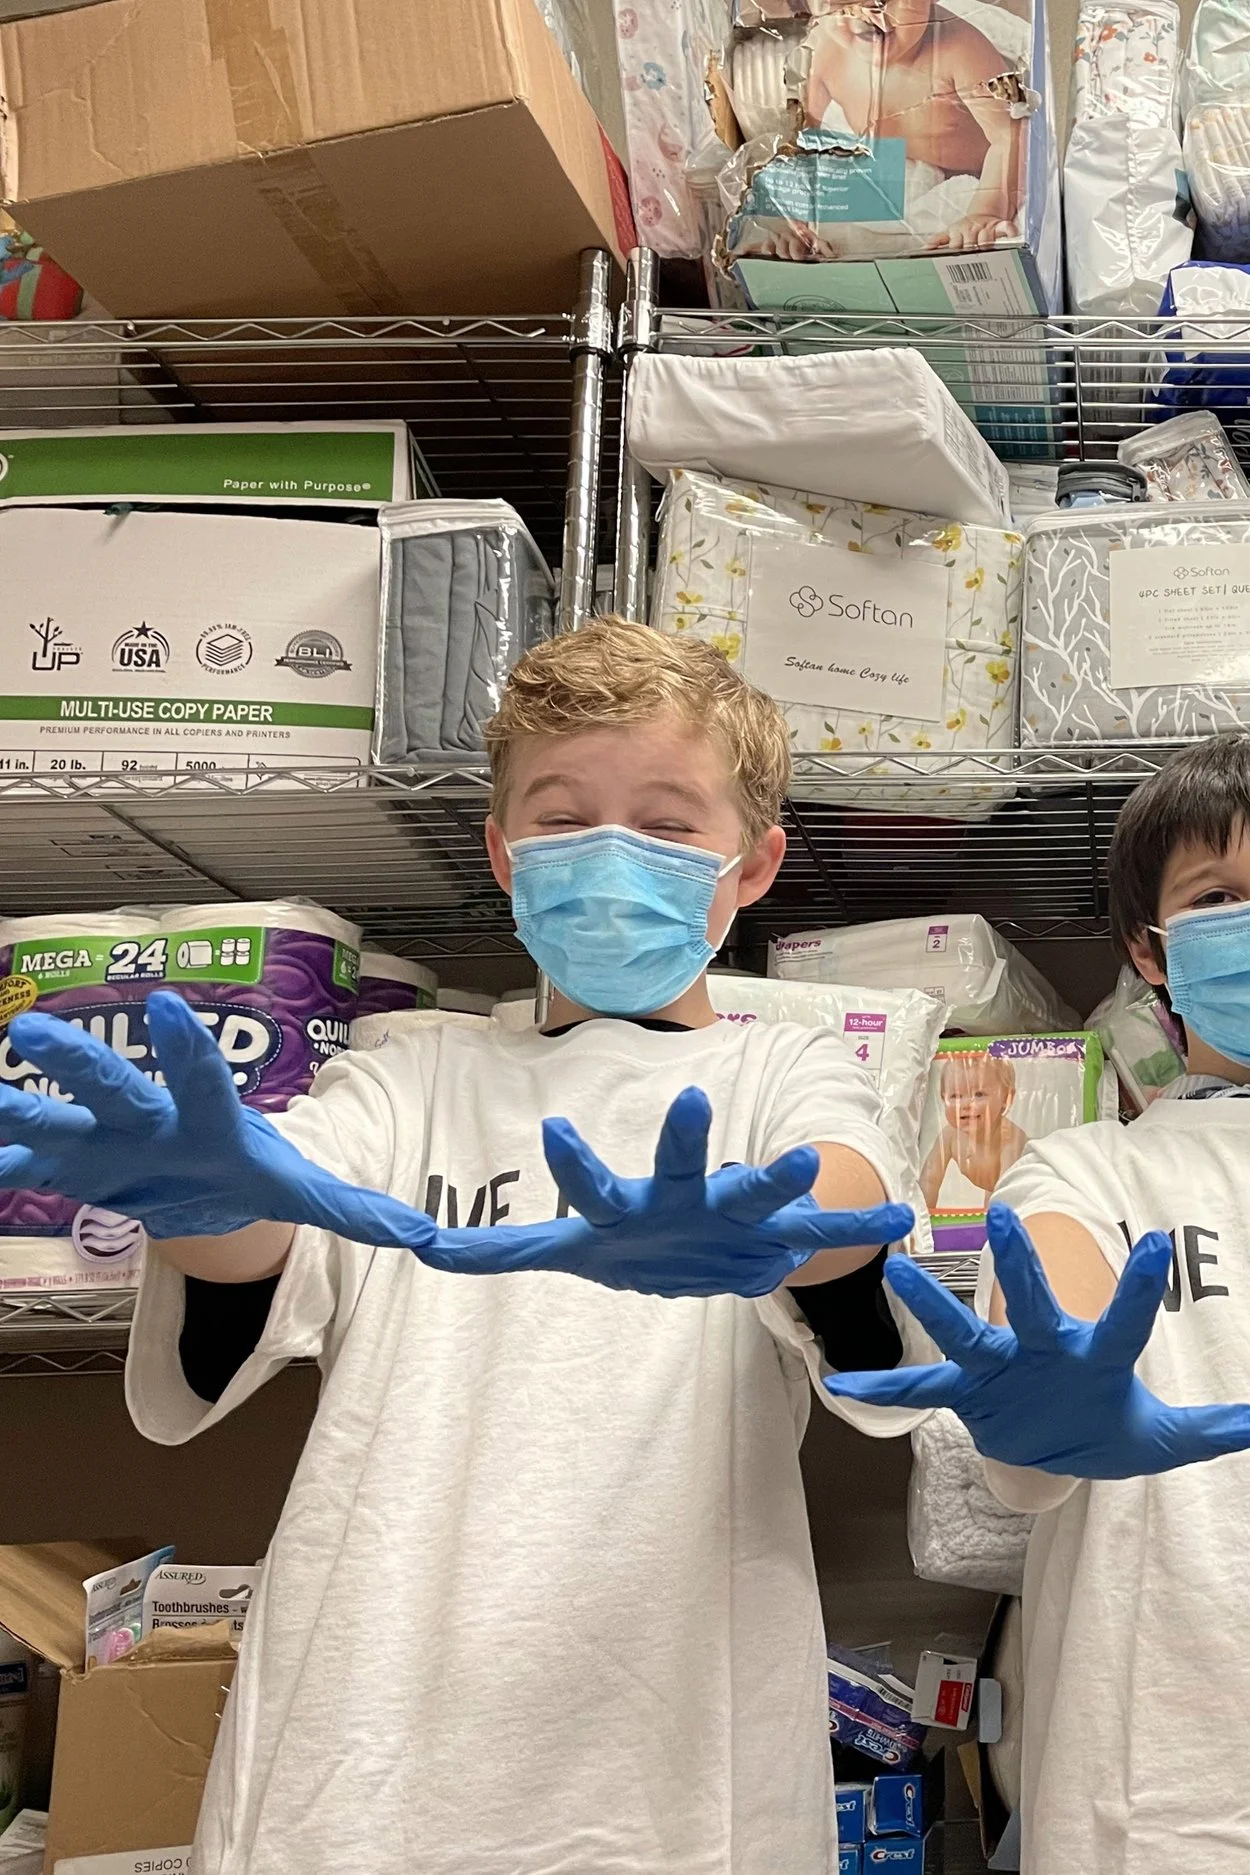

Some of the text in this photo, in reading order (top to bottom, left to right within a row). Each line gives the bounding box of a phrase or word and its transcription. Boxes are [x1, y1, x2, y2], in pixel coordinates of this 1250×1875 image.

[224, 479, 264, 490] Paper
[270, 481, 297, 490] with
[1190, 566, 1230, 577] Softan
[1164, 586, 1197, 597] SHEET
[828, 594, 913, 629] Softan
[119, 648, 161, 668] USA
[299, 647, 330, 658] BLI
[201, 663, 247, 675] PERFORMANCE
[785, 656, 823, 671] Softan
[828, 663, 856, 676] home
[860, 667, 887, 682] Cozy
[60, 700, 273, 722] MULTI-USE COPY PAPER
[39, 726, 291, 739] PREMIUM PERFORMANCE IN ALL COPIERS AND PRINTERS
[15, 759, 29, 770] in.
[50, 759, 86, 770] 20 lb.
[121, 760, 137, 771] 92
[186, 761, 216, 770] 5000
[932, 939, 940, 949] 2
[21, 950, 91, 972] MEGA
[108, 939, 167, 974] 24
[107, 971, 164, 981] REGULAR ROLLS
[849, 1018, 883, 1027] 12-hour
[855, 1043, 869, 1061] 4
[155, 1570, 206, 1585] ASSURED
[152, 1601, 229, 1614] Toothbrushes
[854, 1734, 901, 1765] Crest
[903, 1782, 917, 1829] Crest
[870, 1848, 915, 1862] Crest
[134, 1857, 183, 1873] COPIES
